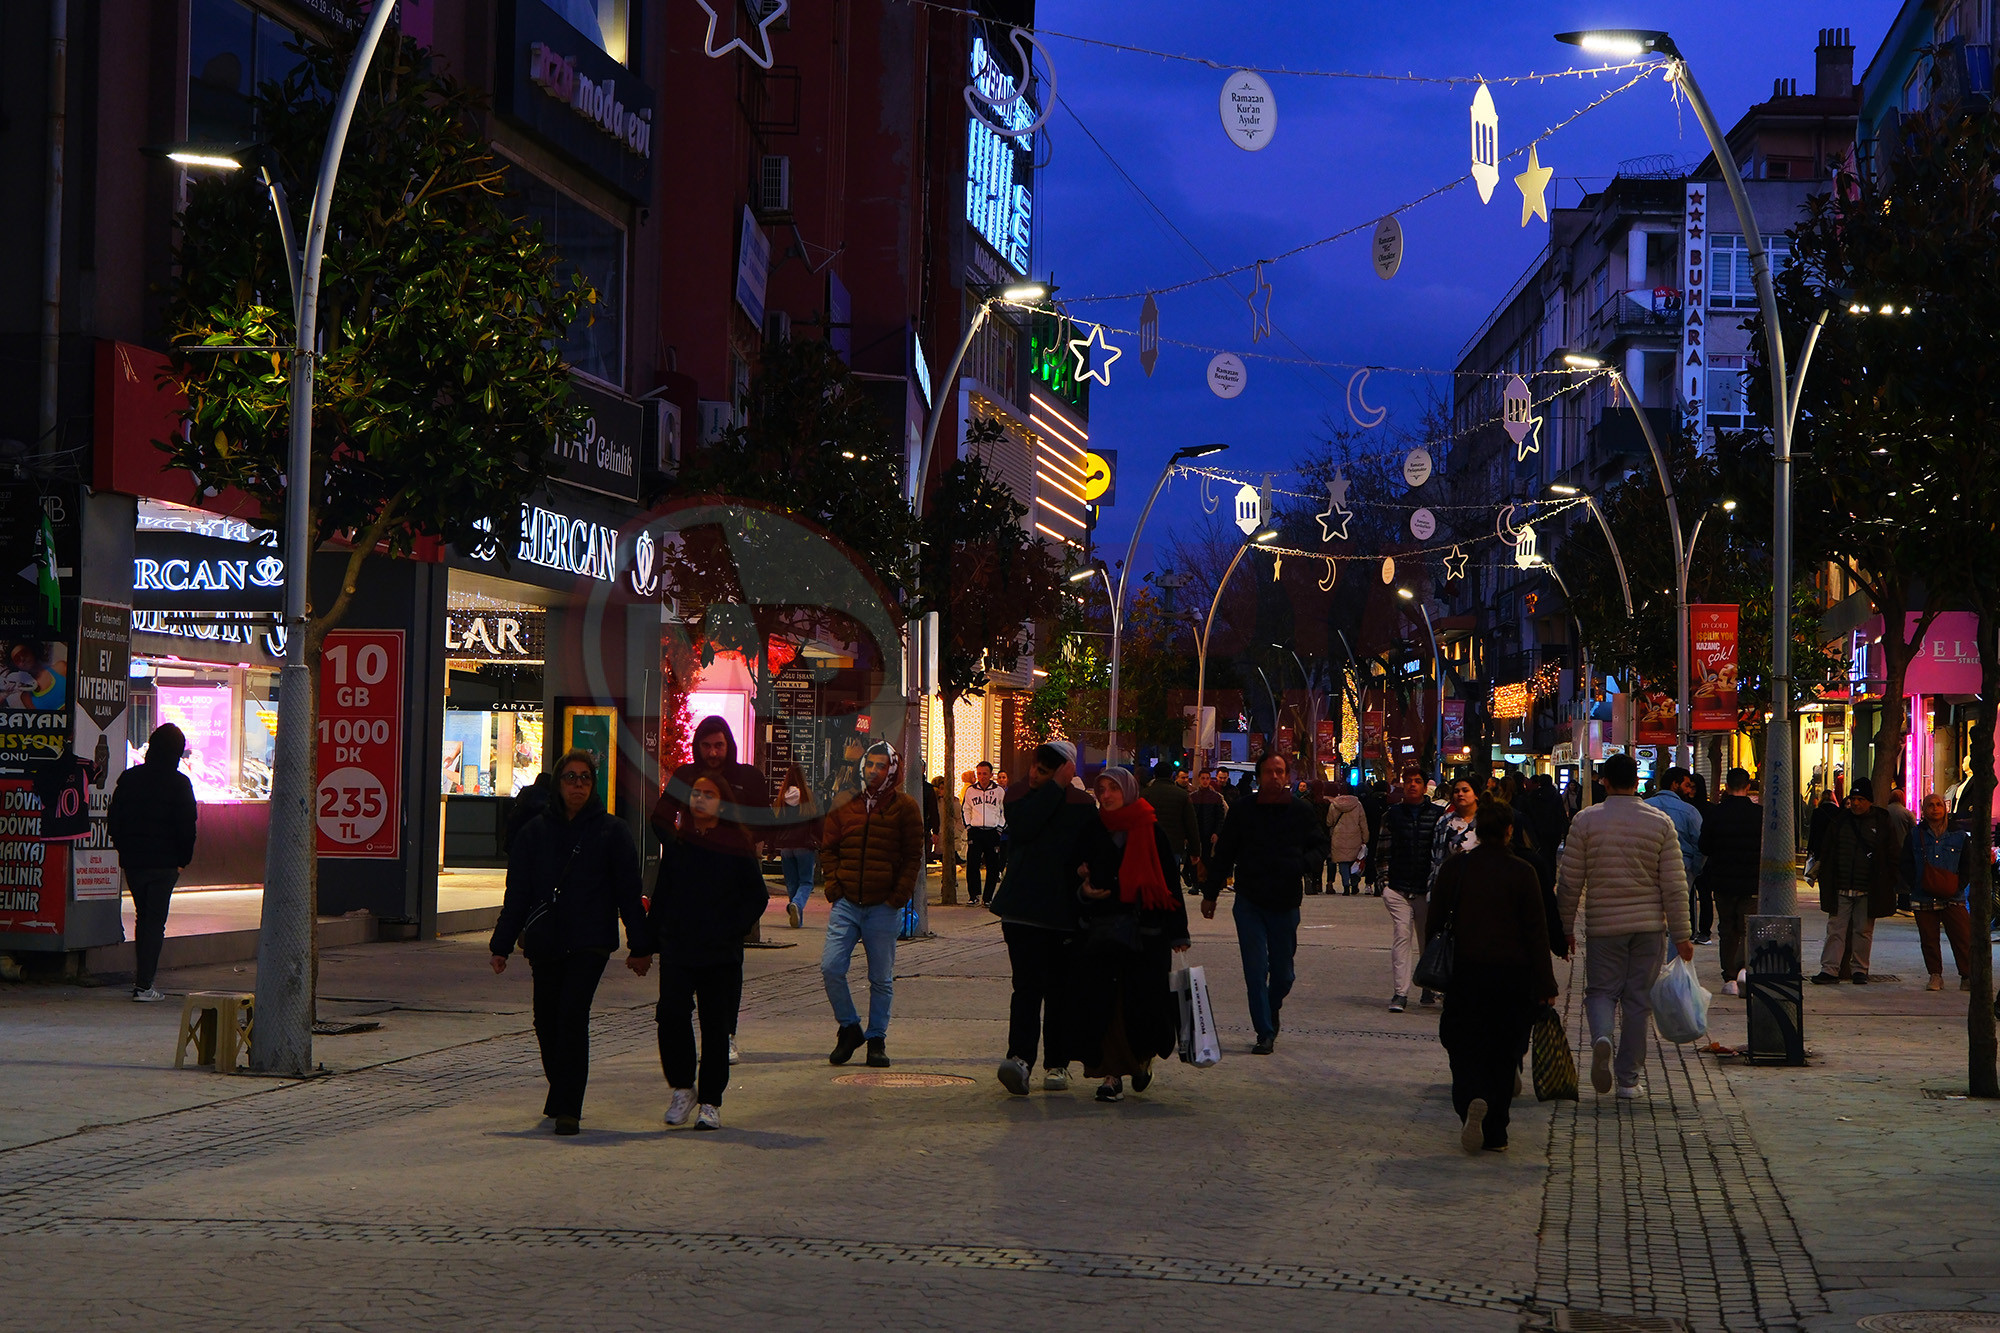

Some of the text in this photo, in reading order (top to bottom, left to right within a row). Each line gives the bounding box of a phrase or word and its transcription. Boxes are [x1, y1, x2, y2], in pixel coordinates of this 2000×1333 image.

[1231, 92, 1265, 104] Ramazan
[577, 71, 625, 141] moda
[627, 106, 652, 160] evi
[1236, 103, 1261, 114] Kur'an
[1238, 114, 1261, 127] Ayıdır
[1686, 249, 1704, 367] BUHARA
[596, 435, 633, 477] Gelinlik
[518, 503, 619, 583] MERCAN
[445, 616, 530, 655] LAR
[1720, 631, 1735, 641] YOK
[99, 649, 113, 672] EV
[324, 644, 389, 685] 10
[337, 686, 370, 708] GB
[94, 704, 113, 717] ALANA
[492, 702, 535, 711] CARAT
[0, 712, 67, 729] BAYAN
[319, 719, 390, 744] 1000
[0, 733, 65, 750] SYON
[335, 747, 363, 763] DK
[319, 786, 381, 818] 235
[971, 795, 997, 806] ITALIA
[339, 822, 361, 839] TL
